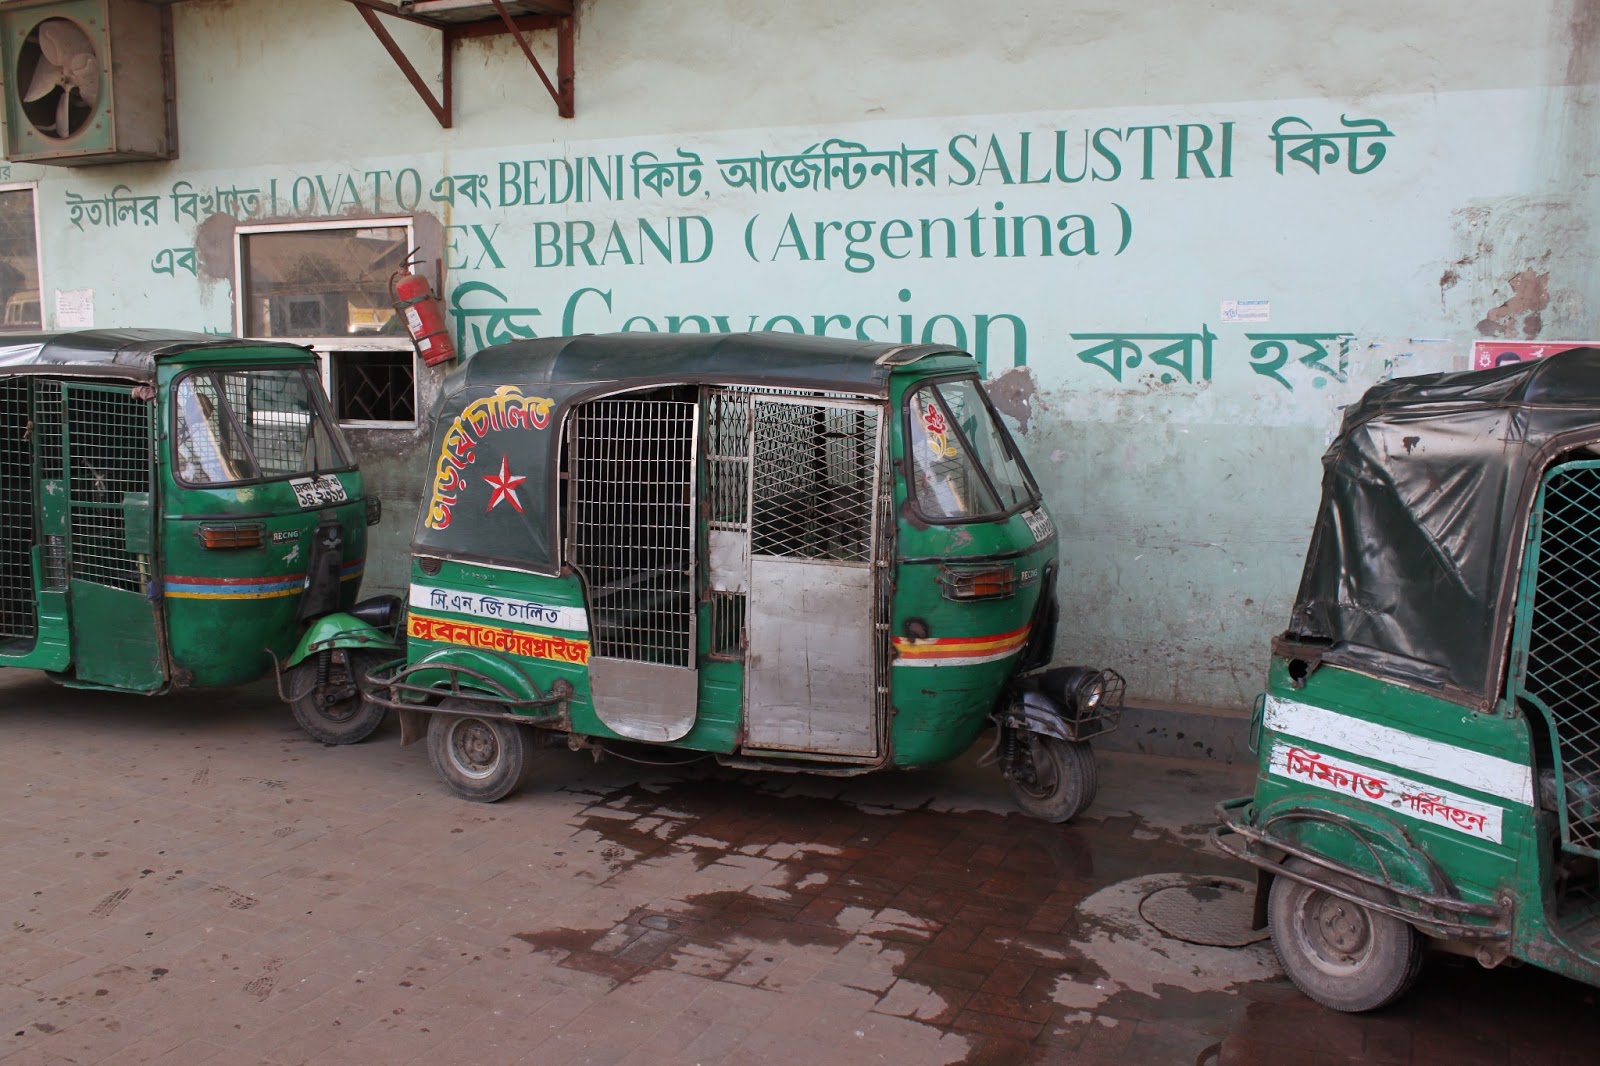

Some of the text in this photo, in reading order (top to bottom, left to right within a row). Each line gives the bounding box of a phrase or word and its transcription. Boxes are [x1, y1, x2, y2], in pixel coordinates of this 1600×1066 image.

[66, 184, 160, 232] ইতালির
[430, 173, 491, 209] এবং
[498, 154, 625, 207] BEDINI
[716, 138, 939, 193] আর্জেন্টিনার
[948, 121, 1234, 186] SALUSTRI
[1268, 115, 1396, 176] কিট
[533, 215, 714, 268] BRAND
[744, 200, 1133, 273] (Argentina)
[1069, 322, 1218, 384] করা
[461, 385, 555, 438] চালিত
[507, 602, 561, 623] চালিত
